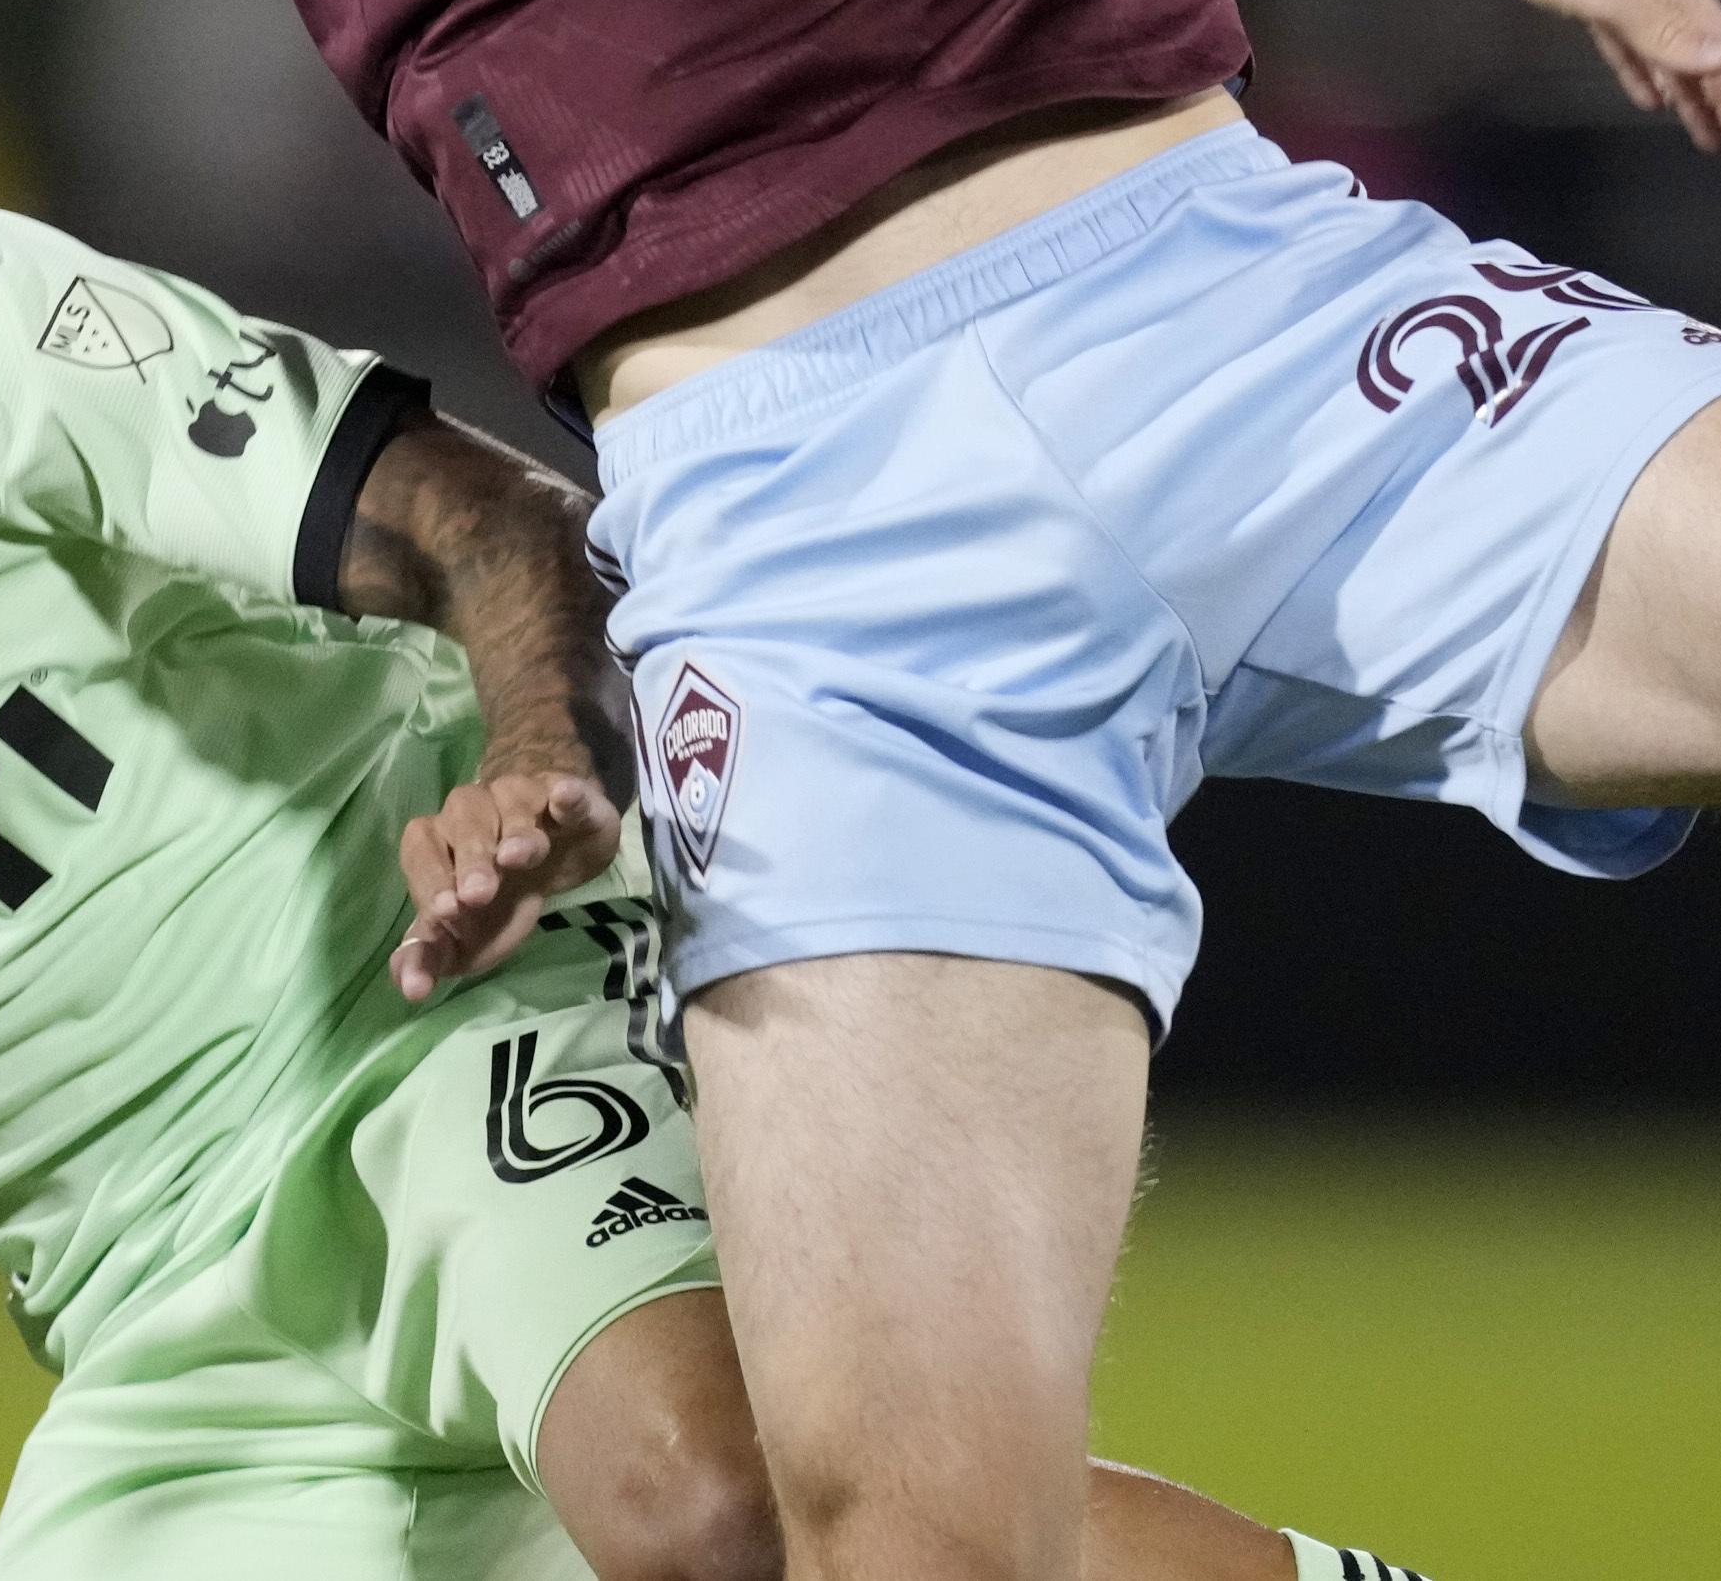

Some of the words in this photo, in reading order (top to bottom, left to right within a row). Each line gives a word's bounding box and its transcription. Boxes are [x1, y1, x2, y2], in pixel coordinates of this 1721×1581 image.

[47, 304, 91, 355] MLS
[665, 708, 729, 761] COLORADO
[486, 1029, 651, 1185] 6
[585, 1204, 708, 1249] adidas
